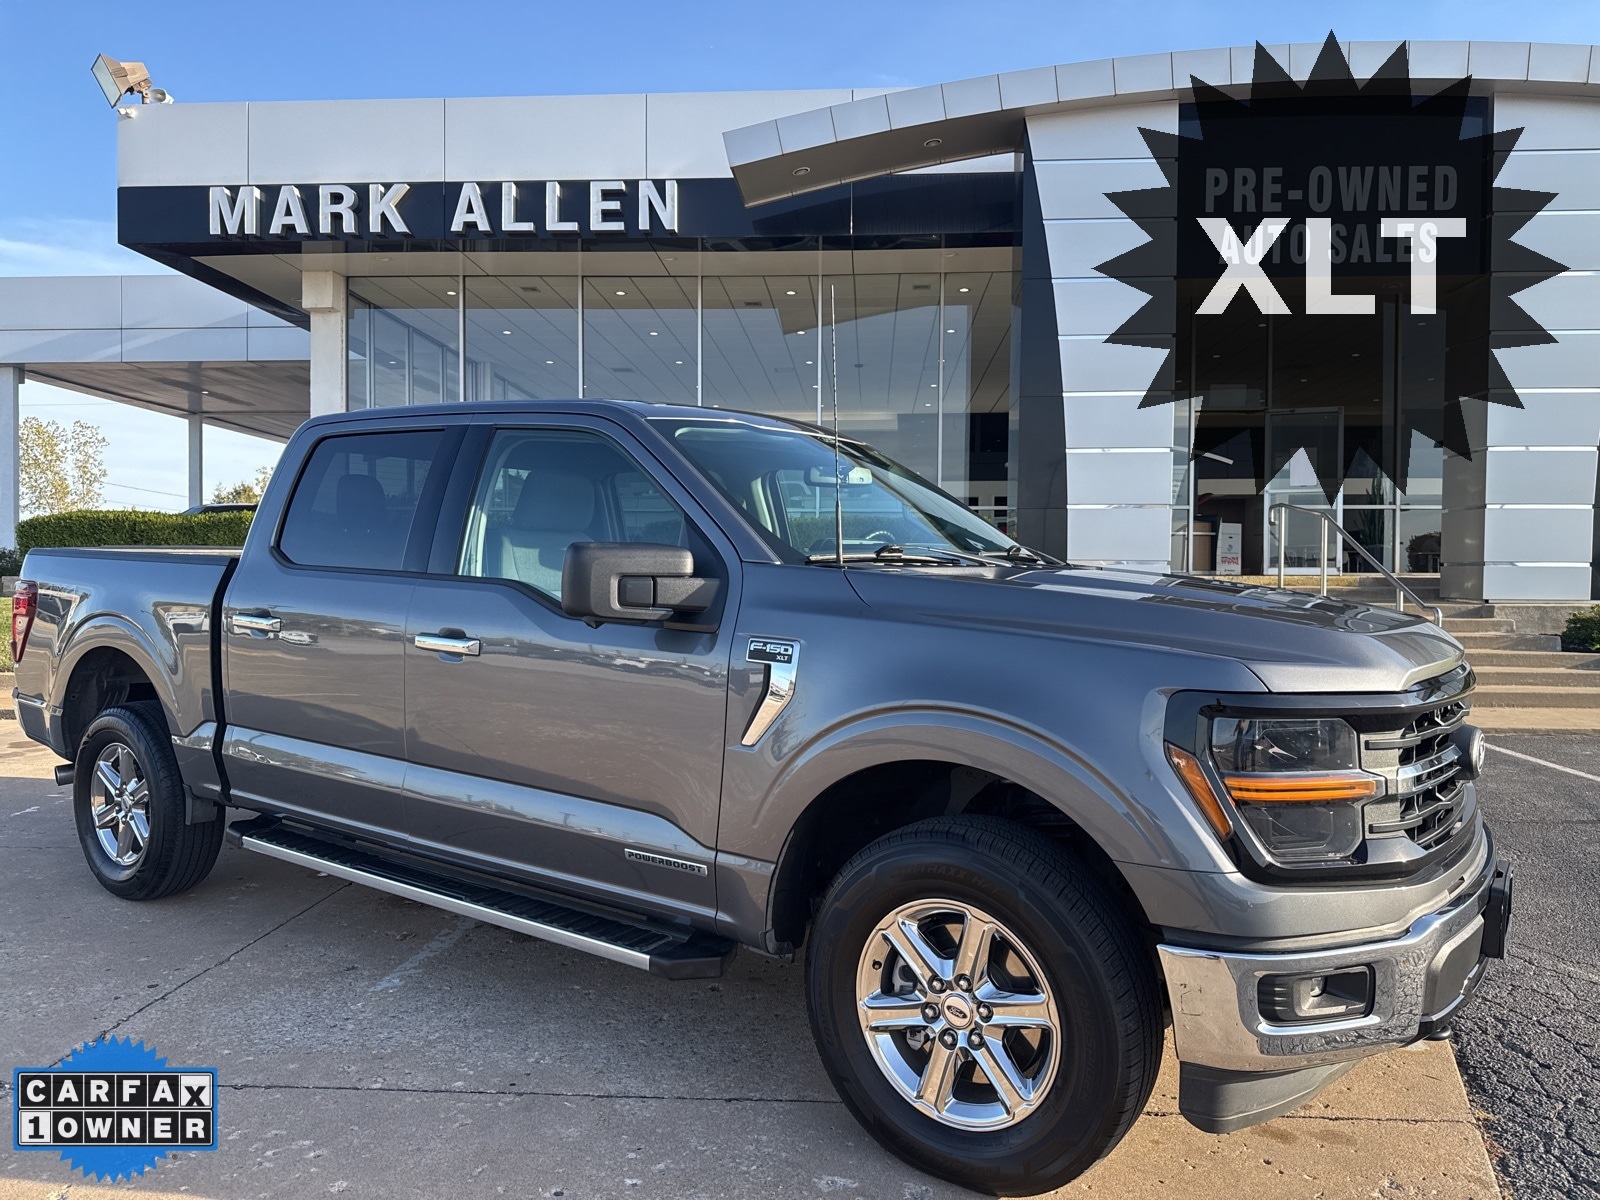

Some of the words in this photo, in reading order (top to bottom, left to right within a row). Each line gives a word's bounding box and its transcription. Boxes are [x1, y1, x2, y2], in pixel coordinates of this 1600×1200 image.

[208, 183, 412, 236] MARK
[450, 180, 679, 235] ALLEN
[1205, 165, 1458, 213] PRE-OWNED
[1218, 223, 1311, 265] AUTO
[1327, 222, 1439, 264] SALES
[750, 642, 793, 655] F-150
[628, 851, 703, 873] POWERBOOST
